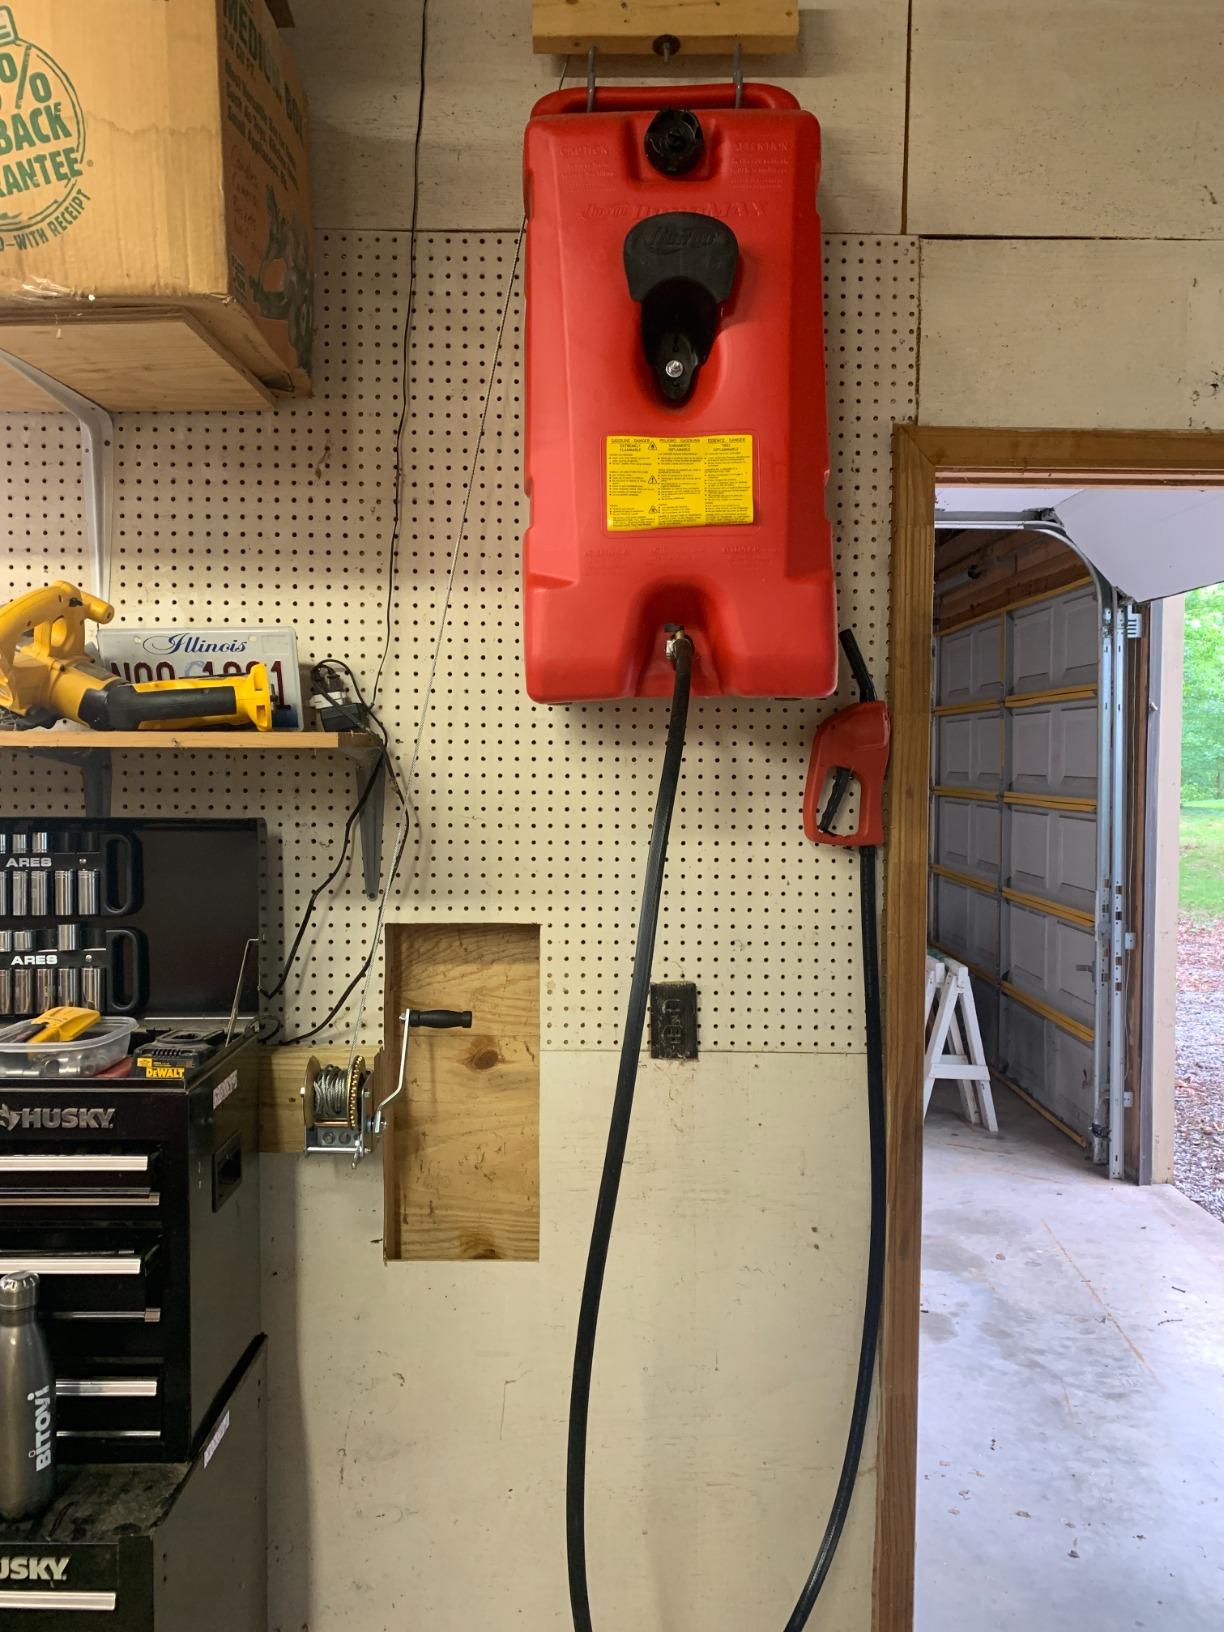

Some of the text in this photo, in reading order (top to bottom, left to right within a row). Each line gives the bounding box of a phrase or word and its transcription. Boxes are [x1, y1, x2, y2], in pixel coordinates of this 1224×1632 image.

[0, 101, 72, 155] BACK
[0, 147, 83, 197] ANTEE
[47, 188, 91, 237] RECEIPT
[143, 633, 247, 655] Illinois
[5, 857, 52, 868] ARES
[11, 954, 58, 966] ARES
[22, 1107, 116, 1129] HUSKY
